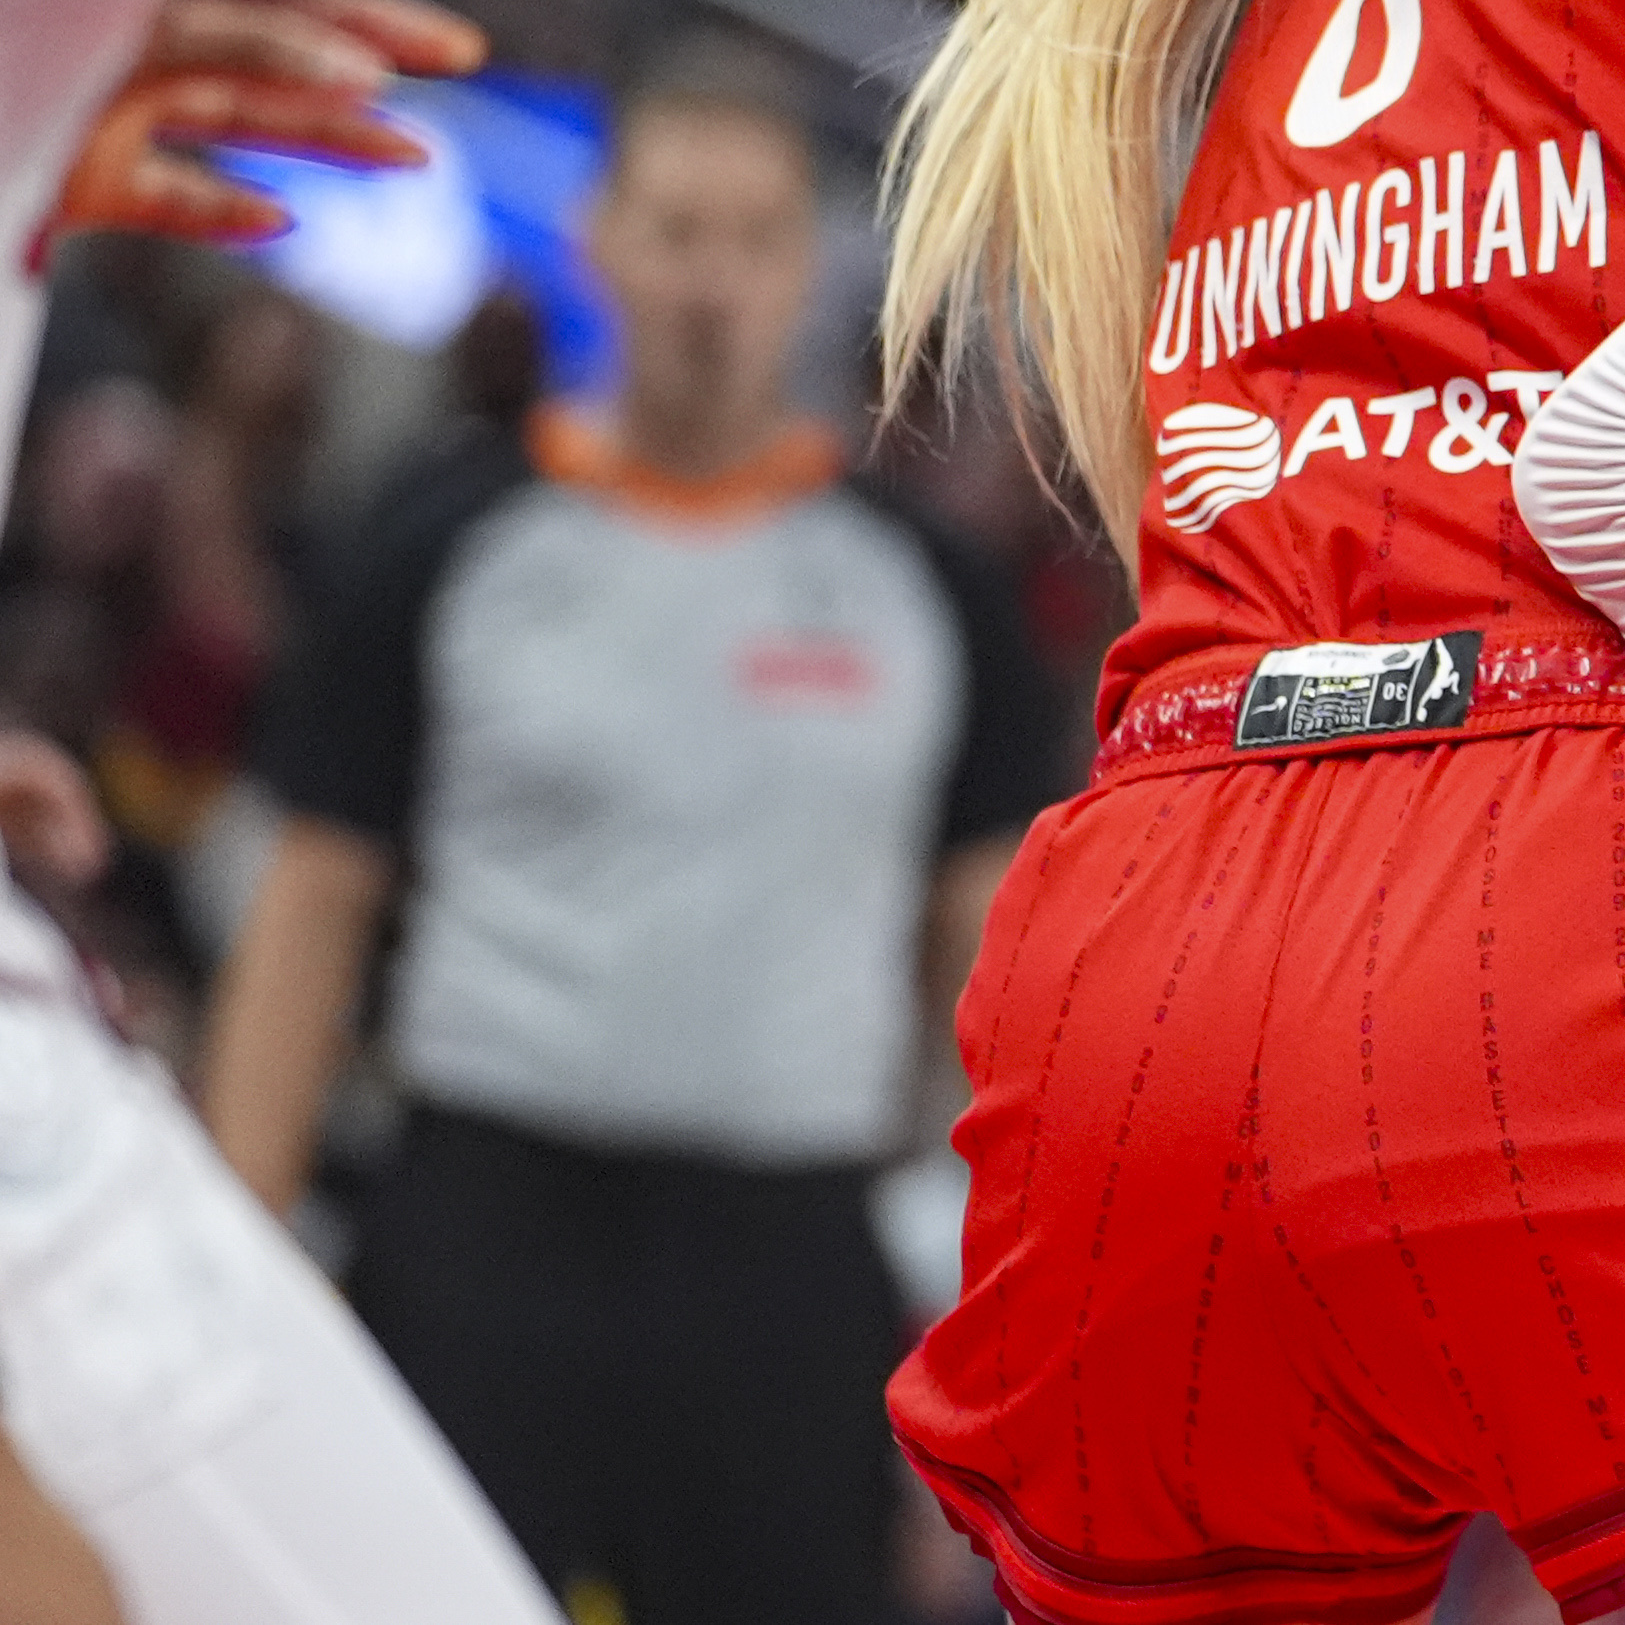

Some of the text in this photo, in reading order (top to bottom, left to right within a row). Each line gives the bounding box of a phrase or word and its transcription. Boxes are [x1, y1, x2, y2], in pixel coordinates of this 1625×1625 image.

[1150, 130, 1607, 374] UNNINGHAM
[1283, 371, 1564, 478] AT&T
[1538, 1254, 1593, 1376] CHOSE
